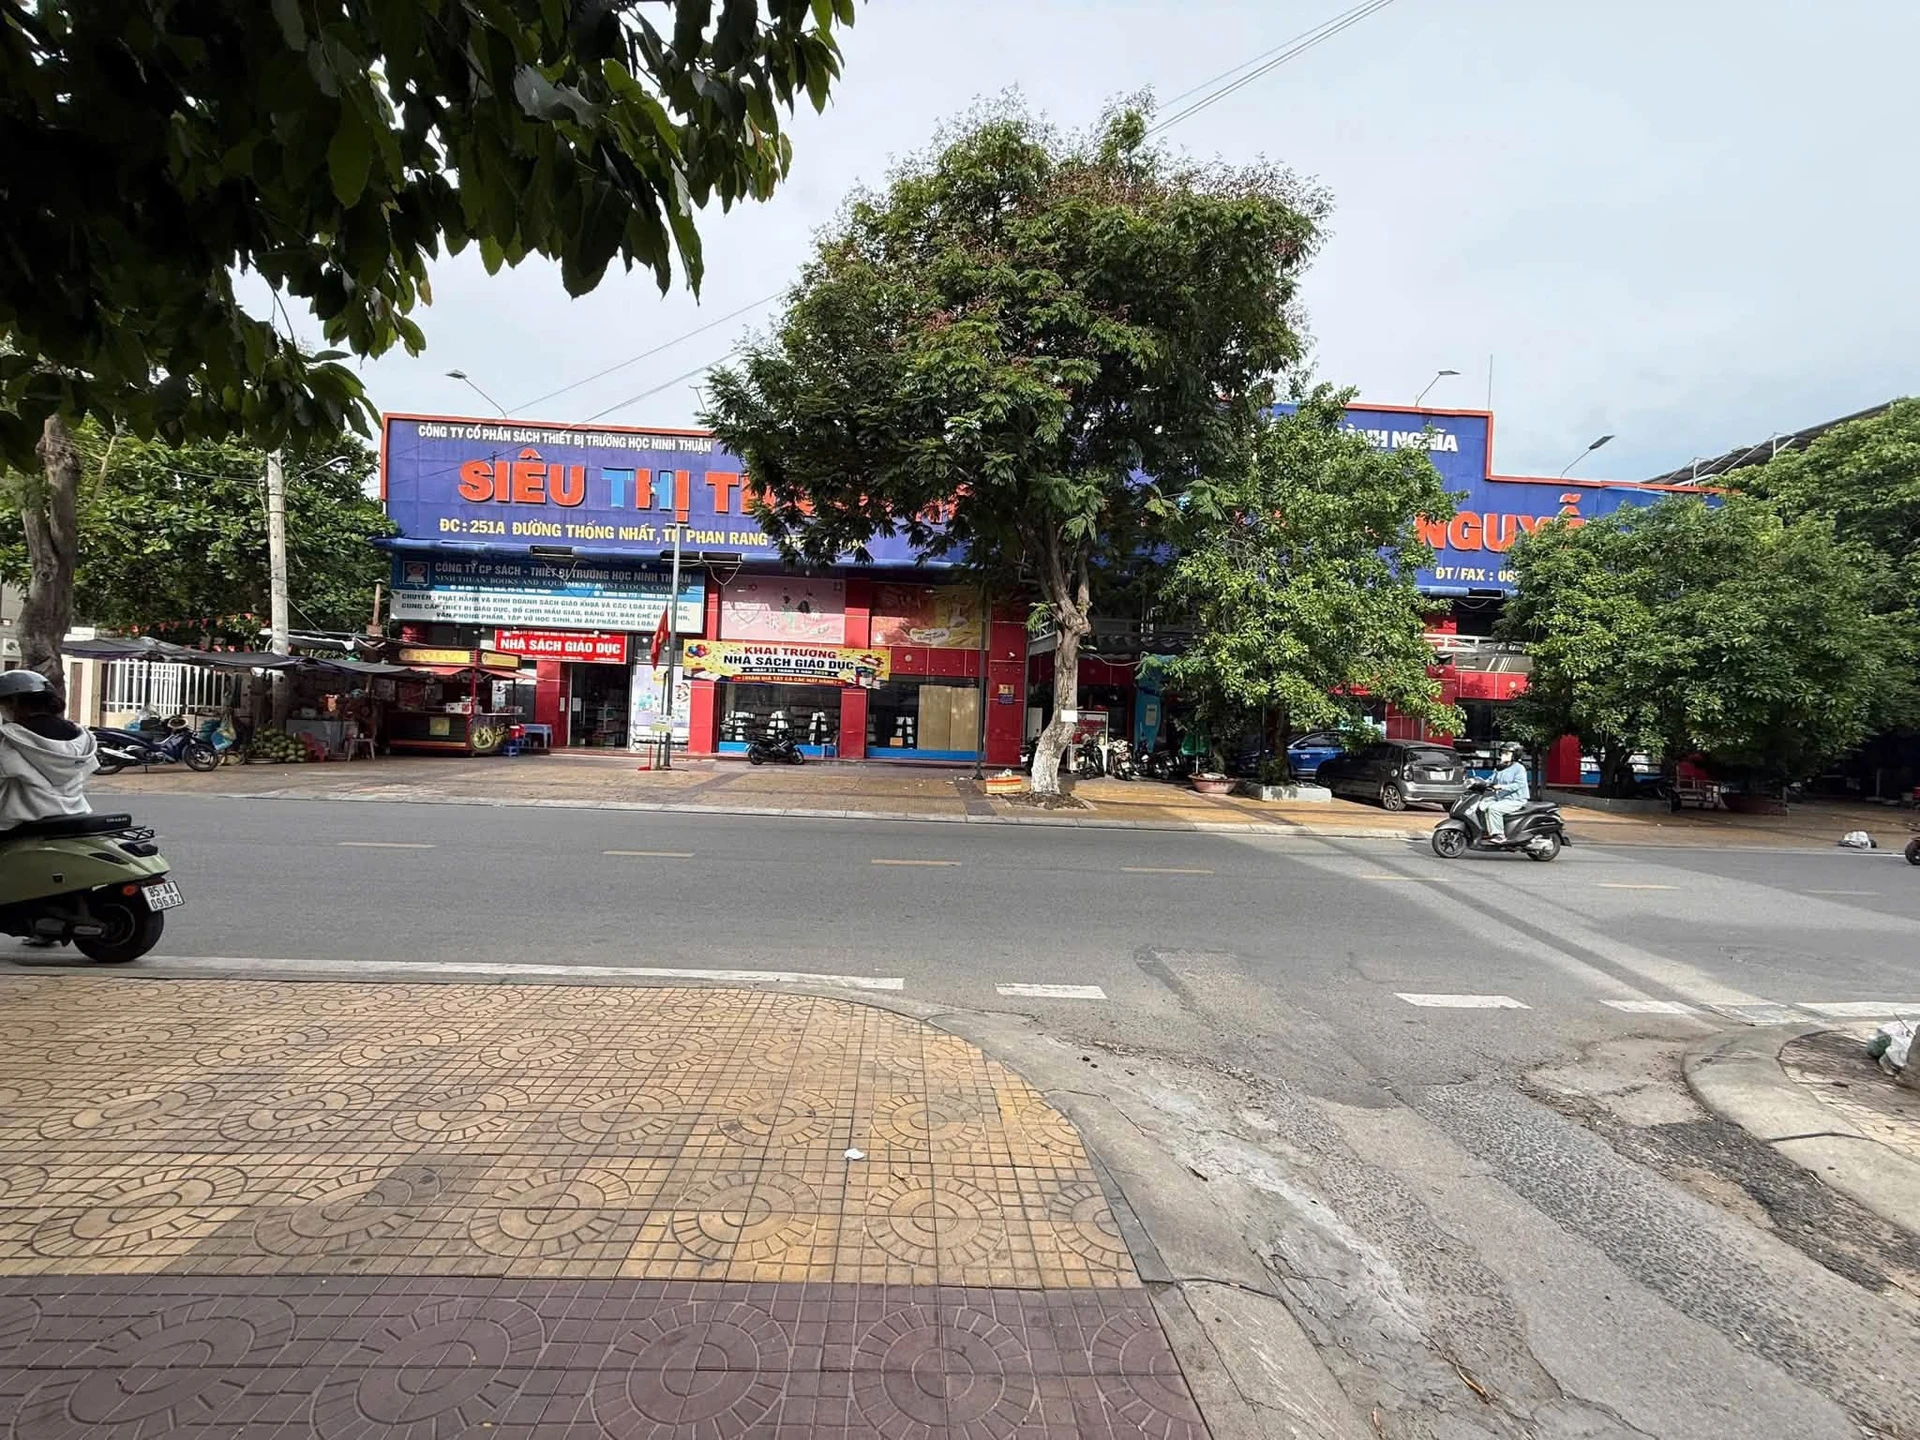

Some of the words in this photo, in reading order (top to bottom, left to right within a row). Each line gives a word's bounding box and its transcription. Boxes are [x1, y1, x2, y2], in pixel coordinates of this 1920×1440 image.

[418, 423, 447, 438] CÔNG
[450, 426, 464, 438] TY
[513, 429, 540, 443] SÁCH
[542, 430, 571, 445] THIẾT
[574, 435, 584, 449] BỊ
[586, 433, 626, 448] TRƯỜNG
[628, 437, 650, 451] HỌC
[651, 438, 676, 451] NINH
[678, 438, 712, 455] THUẬN
[457, 447, 586, 507] SIÊU
[600, 467, 690, 522] THỊ
[469, 520, 506, 534] 251A
[512, 519, 562, 537] ĐƯỜNG
[565, 519, 615, 540] THỐNG
[686, 530, 725, 545] PHAN
[729, 531, 768, 546] RANG
[479, 564, 493, 574] CP
[494, 564, 521, 576] SÁCH
[633, 571, 657, 582] NINH
[500, 637, 526, 650] NHÀ
[528, 638, 562, 651] SÁCH
[564, 639, 593, 653] GIÁO
[596, 642, 621, 656] DỤC
[744, 646, 777, 655] KHAI
[781, 647, 837, 659] TRƯƠNG
[723, 655, 751, 665] NHÀ
[755, 655, 791, 667] SÁCH
[795, 657, 825, 668] GIÁO
[828, 660, 856, 671] DỤC
[148, 883, 175, 898] 85-AA
